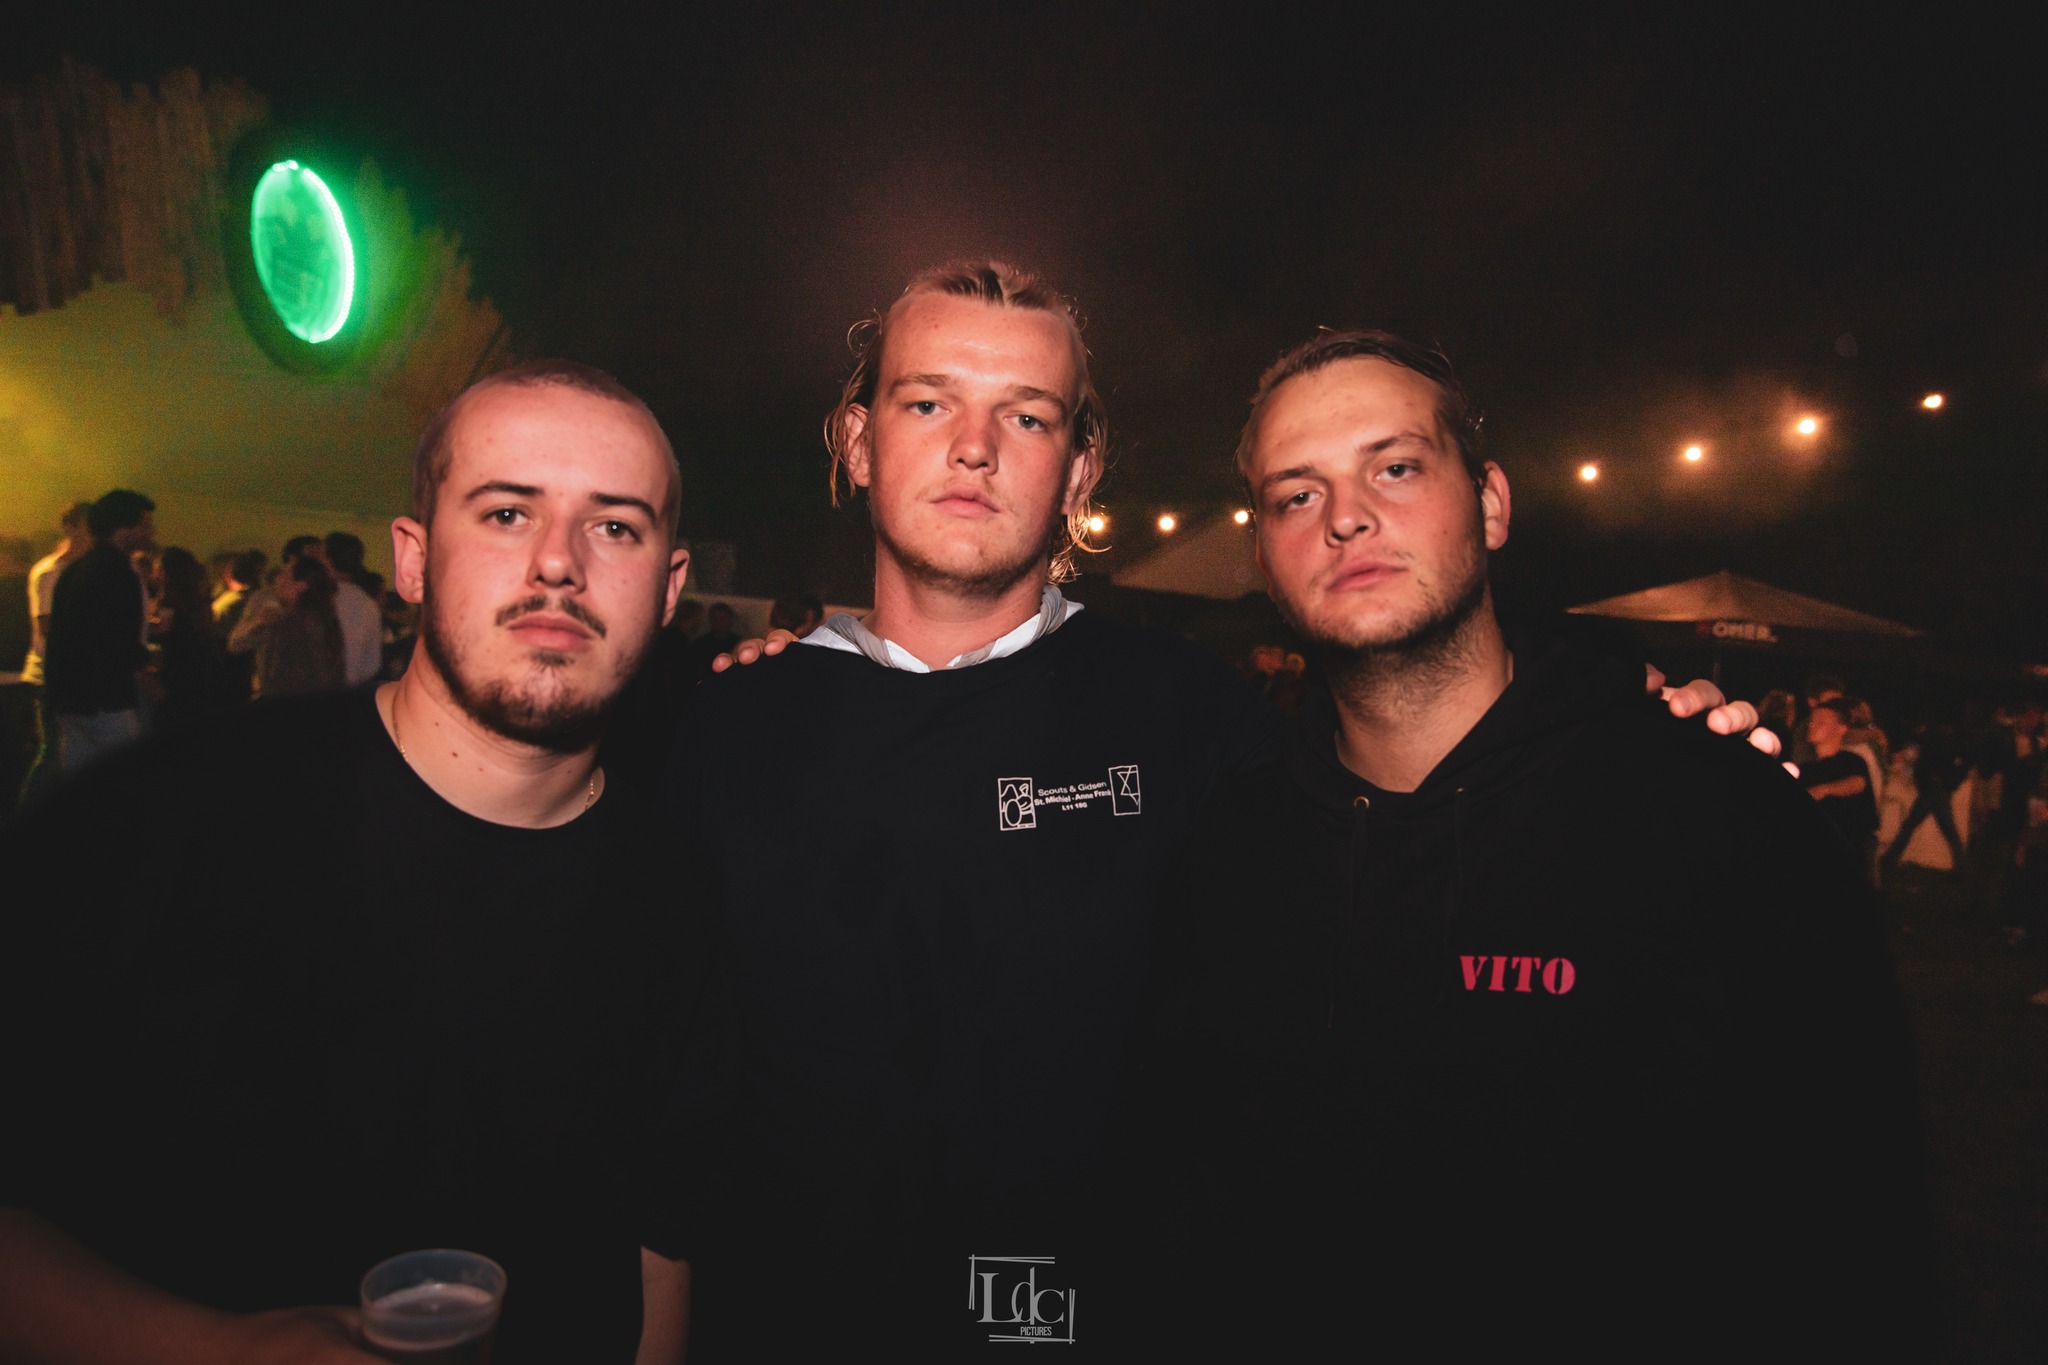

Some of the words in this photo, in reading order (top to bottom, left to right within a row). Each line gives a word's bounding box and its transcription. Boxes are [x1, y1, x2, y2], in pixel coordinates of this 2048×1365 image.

[1038, 788, 1068, 797] Scouts
[1069, 785, 1076, 793] &
[1078, 781, 1107, 791] Gidsen
[1034, 798, 1045, 806] St.
[1046, 794, 1071, 804] Michiel
[1075, 793, 1093, 801] Anne
[1460, 955, 1576, 995] VITO
